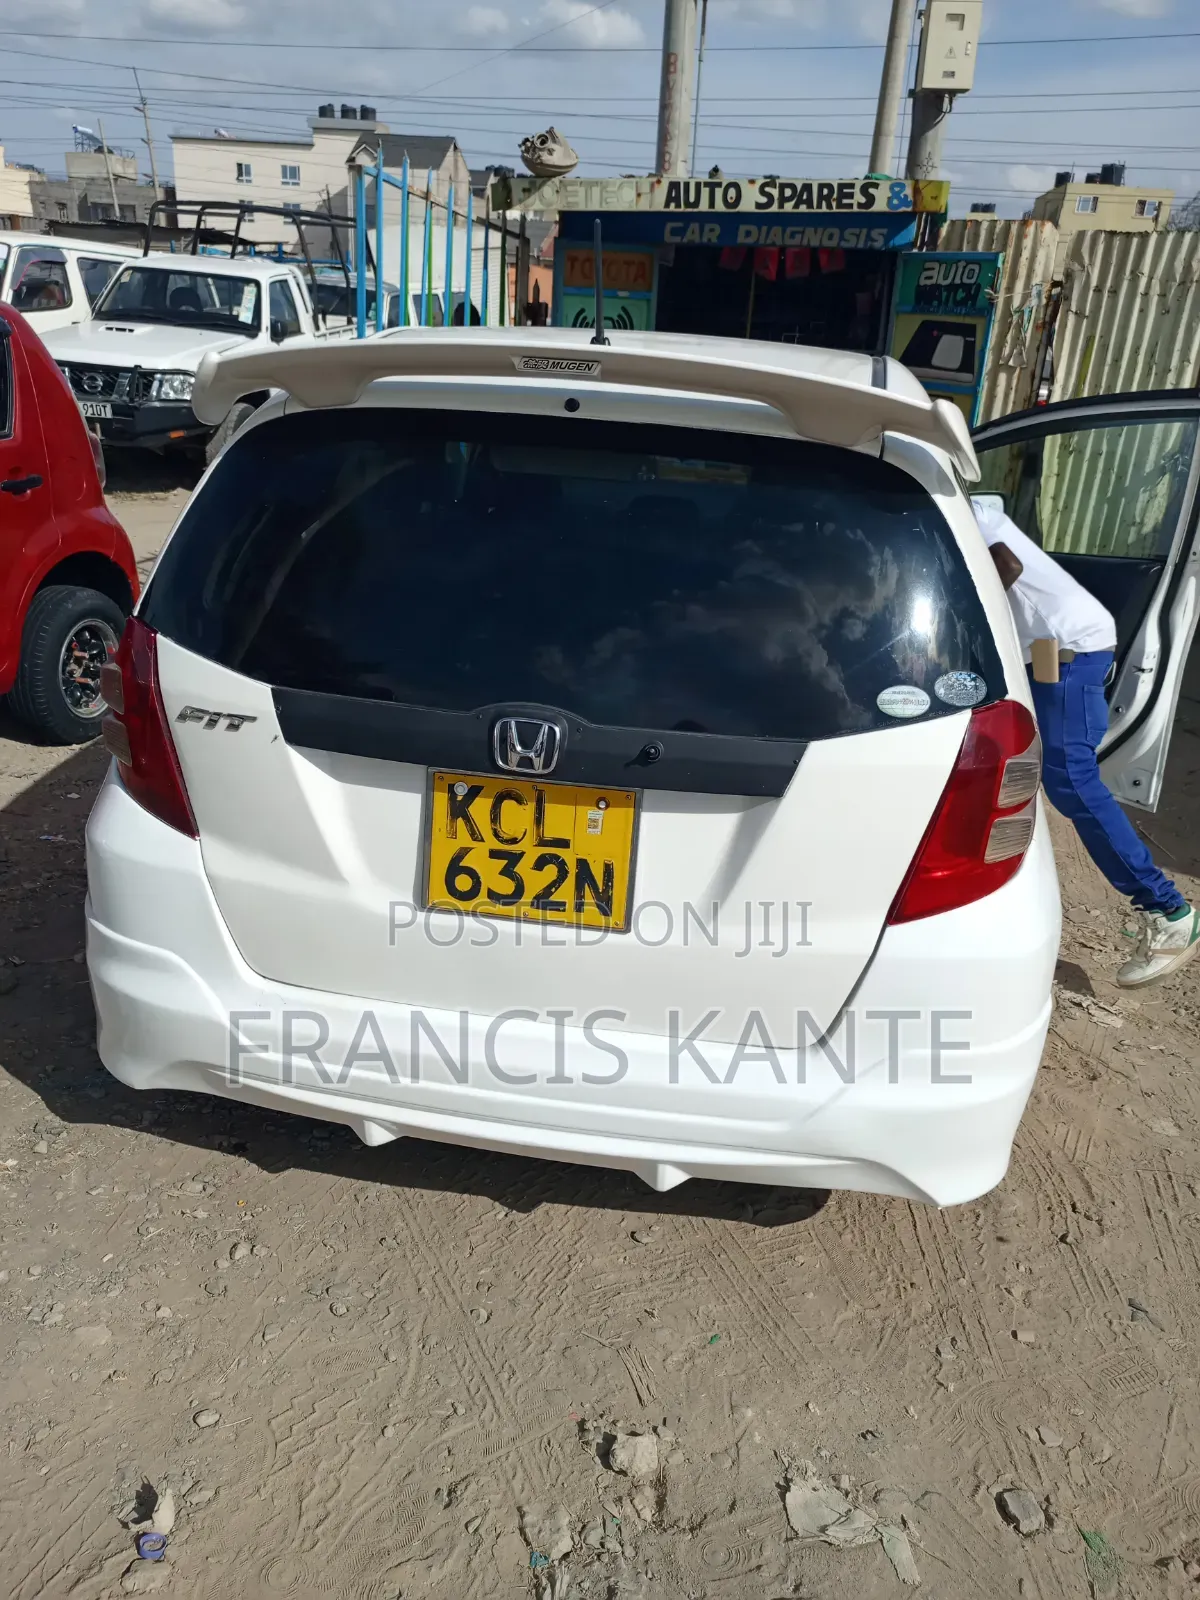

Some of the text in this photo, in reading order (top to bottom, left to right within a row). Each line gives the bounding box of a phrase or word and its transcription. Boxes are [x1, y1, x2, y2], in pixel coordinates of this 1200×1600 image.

[664, 181, 742, 210] AUTO
[754, 182, 880, 211] SPARES
[886, 182, 912, 211] &
[663, 222, 888, 249] CAR DIAGNOSIS
[567, 255, 647, 284] TOOTA
[919, 260, 981, 286] auto
[549, 361, 595, 372] MUGEN
[174, 705, 258, 732] FIT
[446, 783, 571, 849] KCL
[444, 846, 614, 917] 632N
